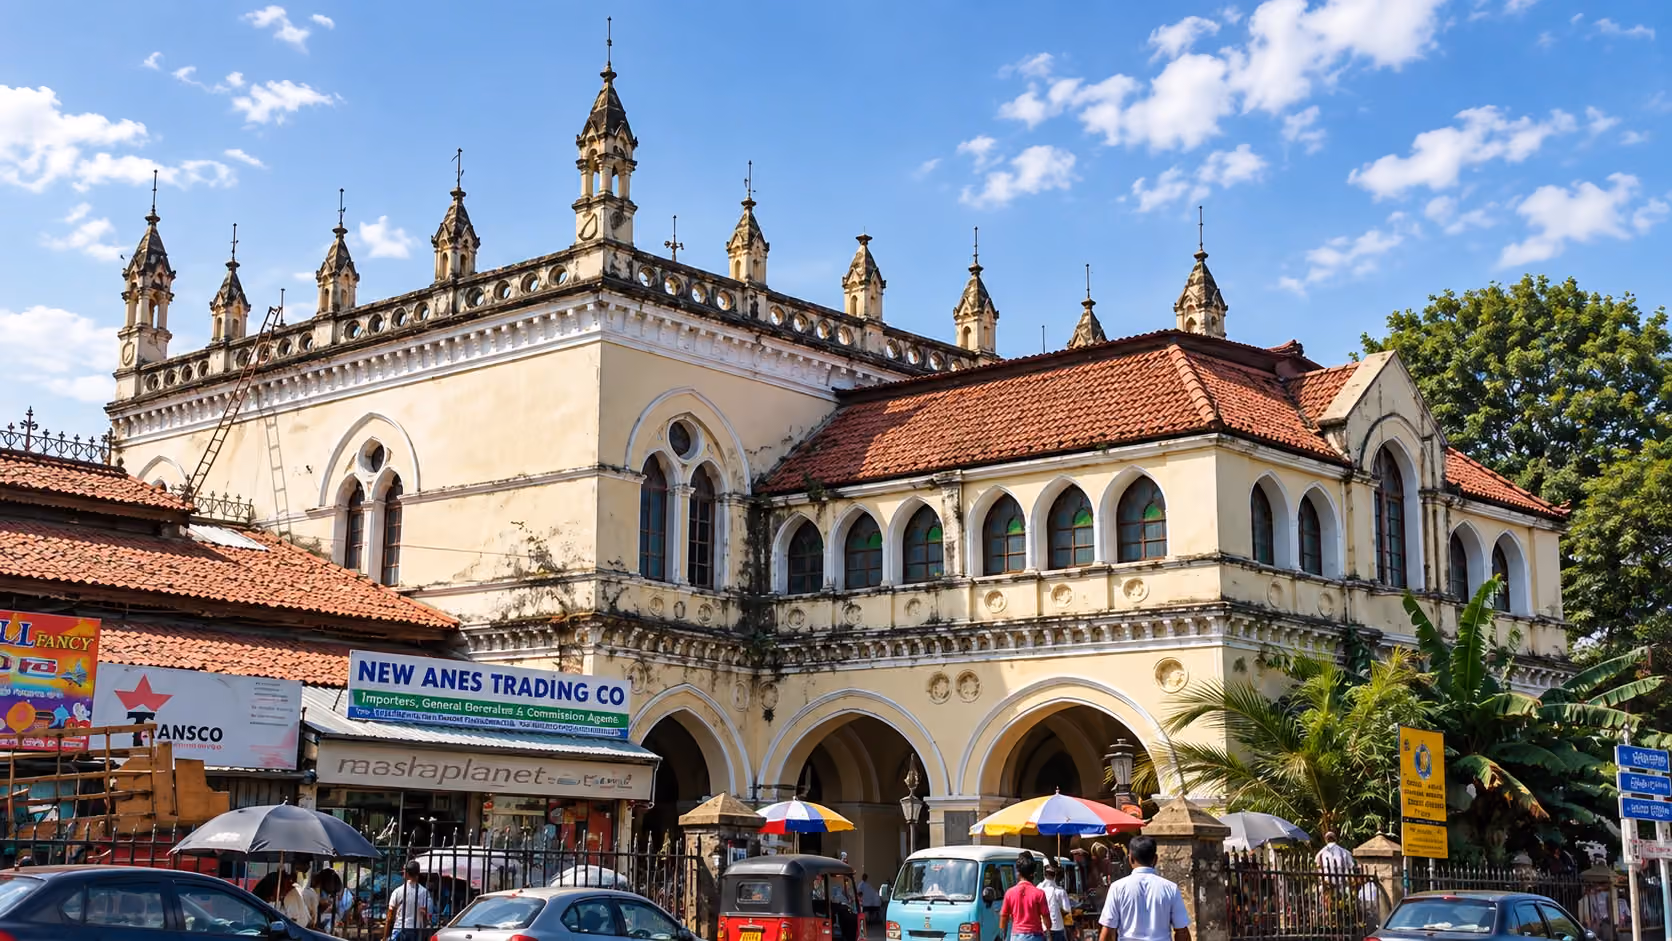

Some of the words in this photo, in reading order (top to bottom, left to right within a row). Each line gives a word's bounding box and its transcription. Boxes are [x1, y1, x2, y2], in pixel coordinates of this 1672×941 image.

[36, 632, 94, 651] FANCY
[358, 660, 415, 685] NEW
[421, 667, 483, 692] ANES
[597, 685, 625, 706] CO
[362, 692, 420, 708] Importers,
[422, 698, 462, 711] General
[527, 707, 585, 722] Commission
